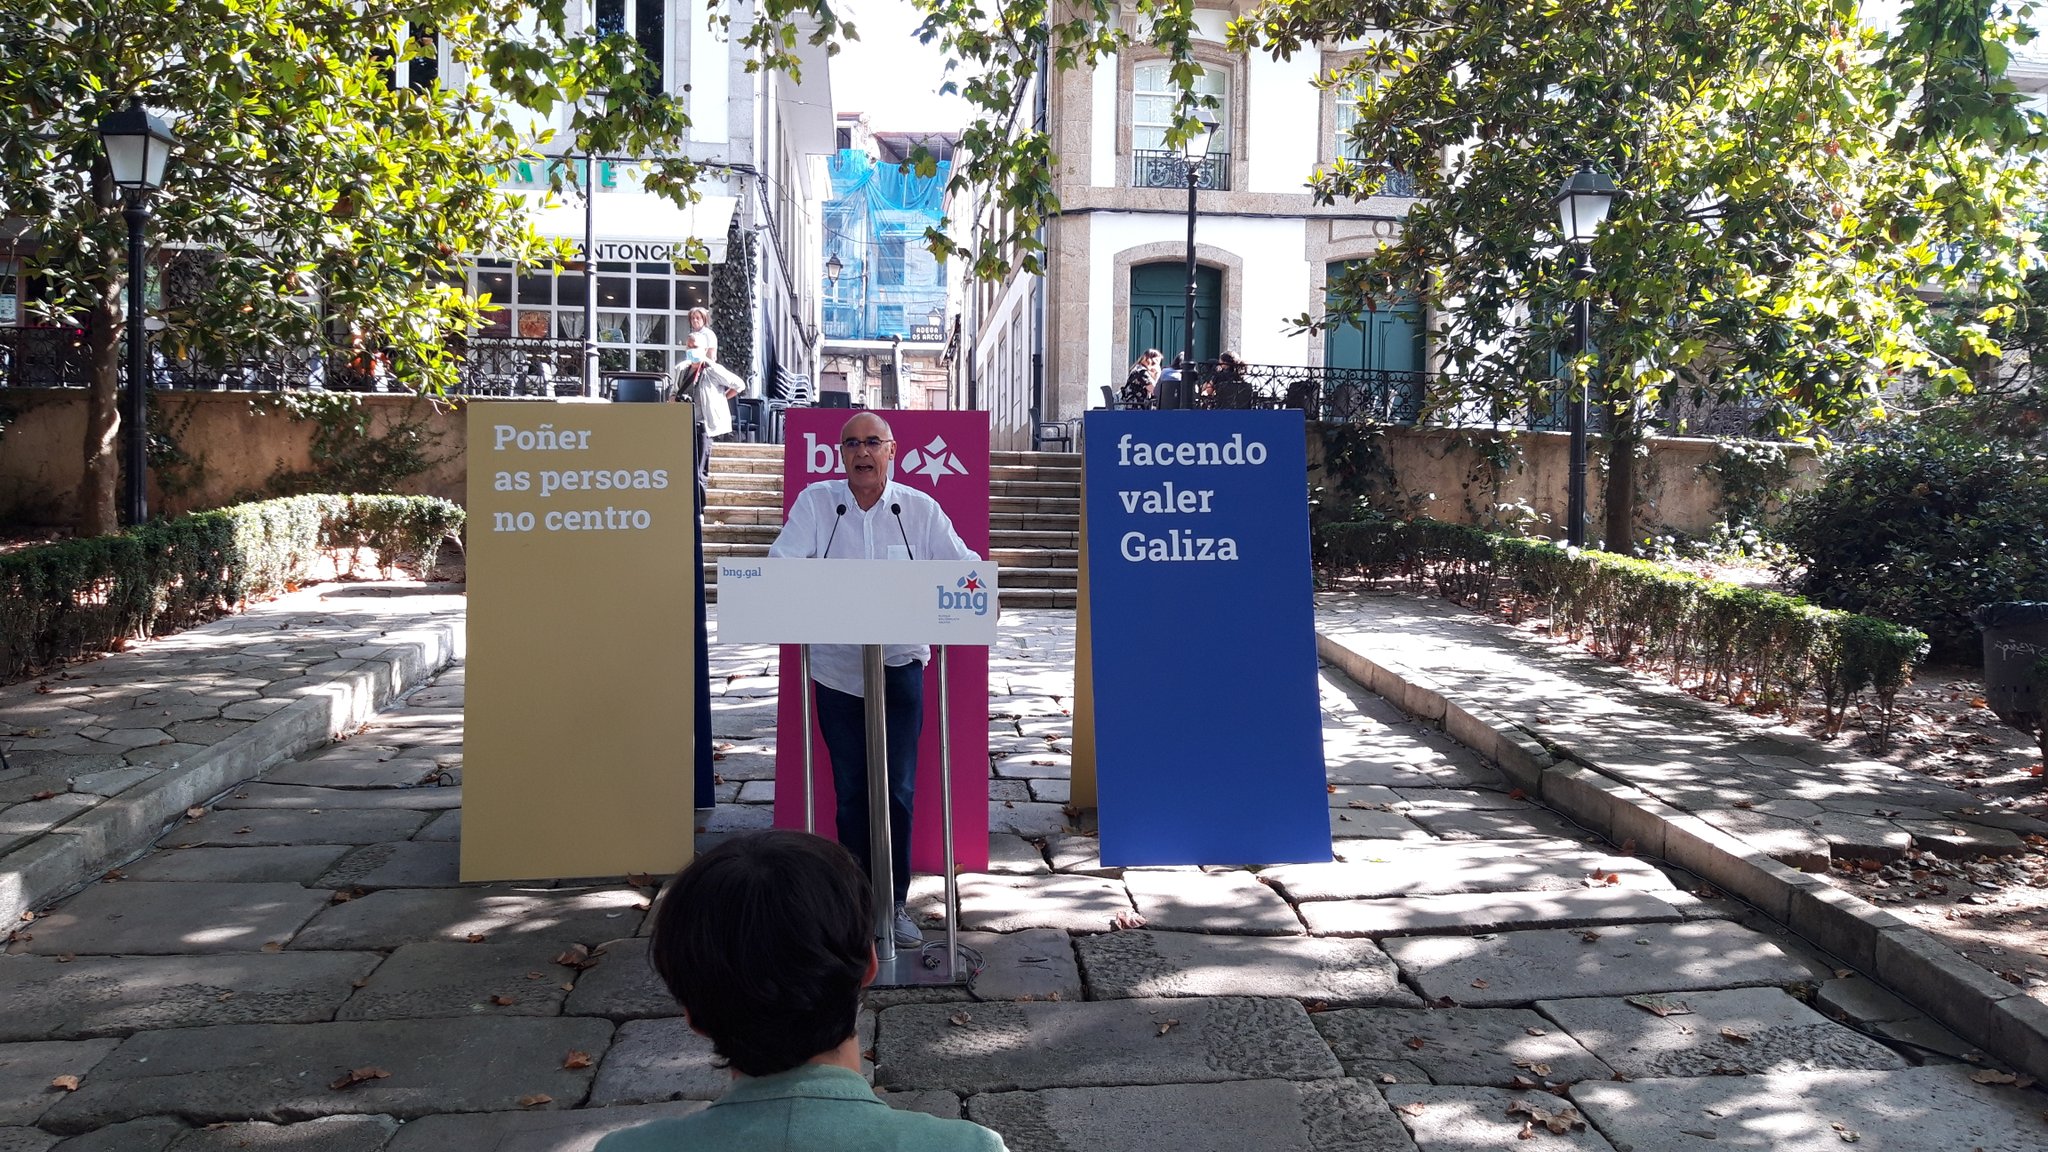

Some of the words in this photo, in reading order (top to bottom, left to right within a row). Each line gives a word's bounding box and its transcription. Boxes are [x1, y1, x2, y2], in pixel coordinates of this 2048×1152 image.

[912, 333, 921, 341] OS
[922, 333, 943, 341] ARCOS
[494, 424, 592, 450] Poñer
[1117, 433, 1267, 466] facendo
[494, 471, 531, 491] as
[540, 469, 668, 497] persoas
[1118, 481, 1214, 514] valer
[493, 511, 536, 532] no
[545, 506, 651, 531] centro
[1120, 529, 1239, 562] Galiza
[722, 566, 762, 579] bng.gal
[936, 585, 988, 616] bng
